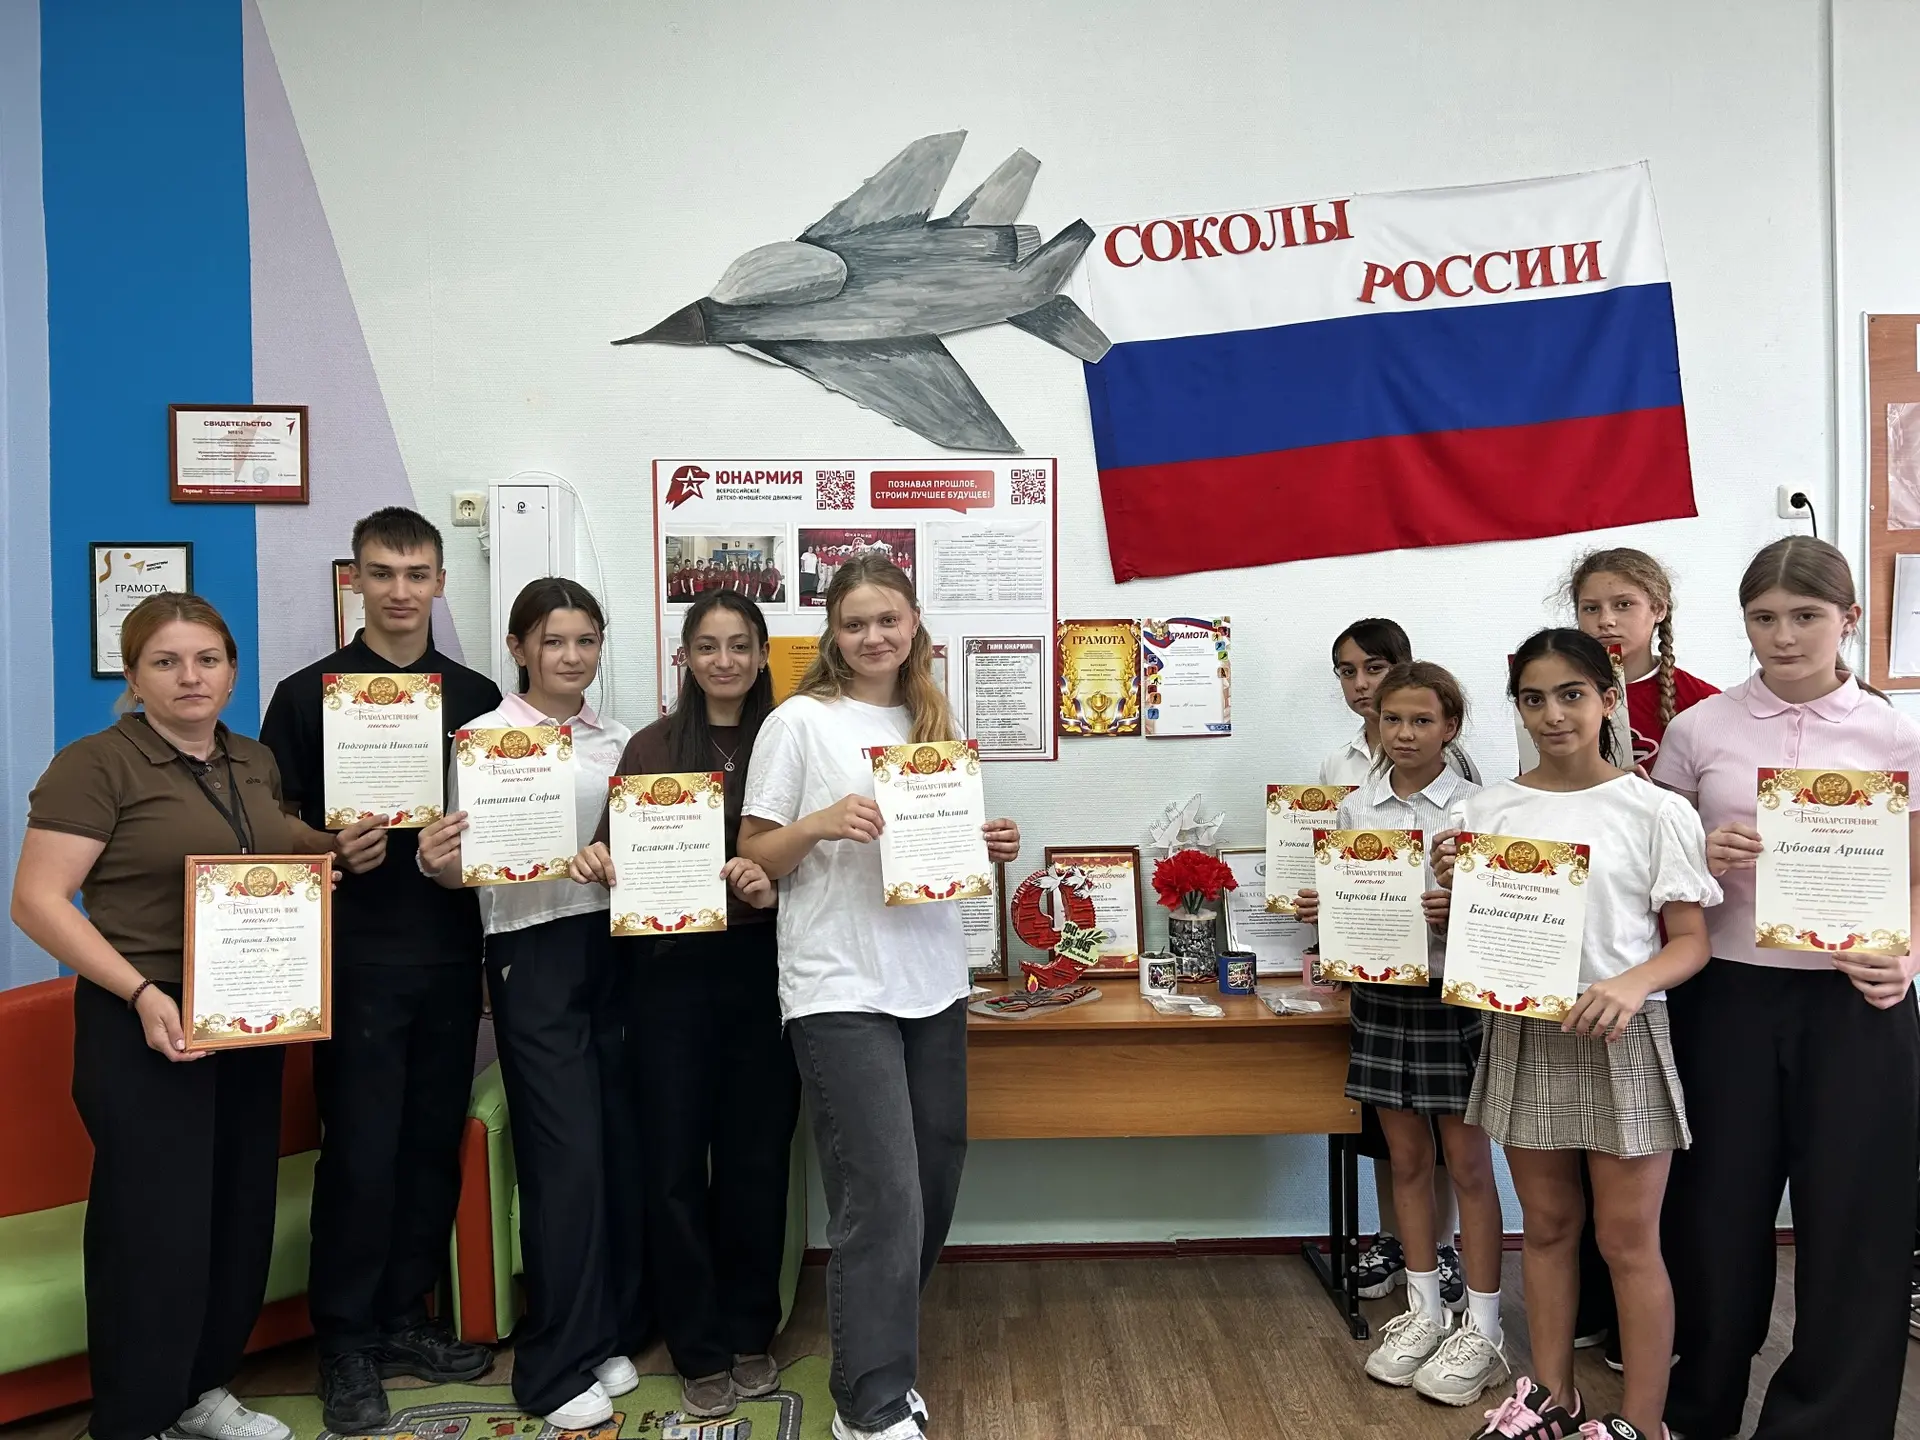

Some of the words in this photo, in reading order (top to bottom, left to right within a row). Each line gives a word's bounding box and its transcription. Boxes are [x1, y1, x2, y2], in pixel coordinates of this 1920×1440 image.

[1104, 199, 1354, 268] СОКОЛЫ
[1356, 240, 1606, 304] РОССИИ
[203, 420, 272, 428] СВИДЕТЕЛЬСТВО
[715, 470, 803, 485] ЮНАРМИЯ
[888, 480, 932, 488] ПОЗНАВАЯ
[934, 480, 978, 489] ПРОШЛОЕ,
[875, 491, 909, 500] СТРОИМ
[910, 491, 946, 499] ЛУЧШЕЕ
[947, 490, 991, 501] БУДУЩЕЕ!
[115, 584, 168, 593] ГРАМОТА
[1072, 635, 1126, 645] ГРАМОТА
[1169, 631, 1209, 641] ГРАМОТА
[337, 742, 387, 751] Подгорный
[389, 741, 429, 749] Николай
[473, 796, 526, 806] Антипина
[529, 793, 561, 803] София
[631, 843, 674, 852] Таслакян
[676, 841, 711, 852] Лусине
[1278, 839, 1310, 848] Узокова
[1773, 841, 1831, 854] Дубовая
[1834, 844, 1885, 857] Ариша
[1335, 890, 1377, 902] Чиркова
[1379, 892, 1407, 902] Ника
[1468, 903, 1539, 922] Багдасарян
[1542, 913, 1566, 926] Ева
